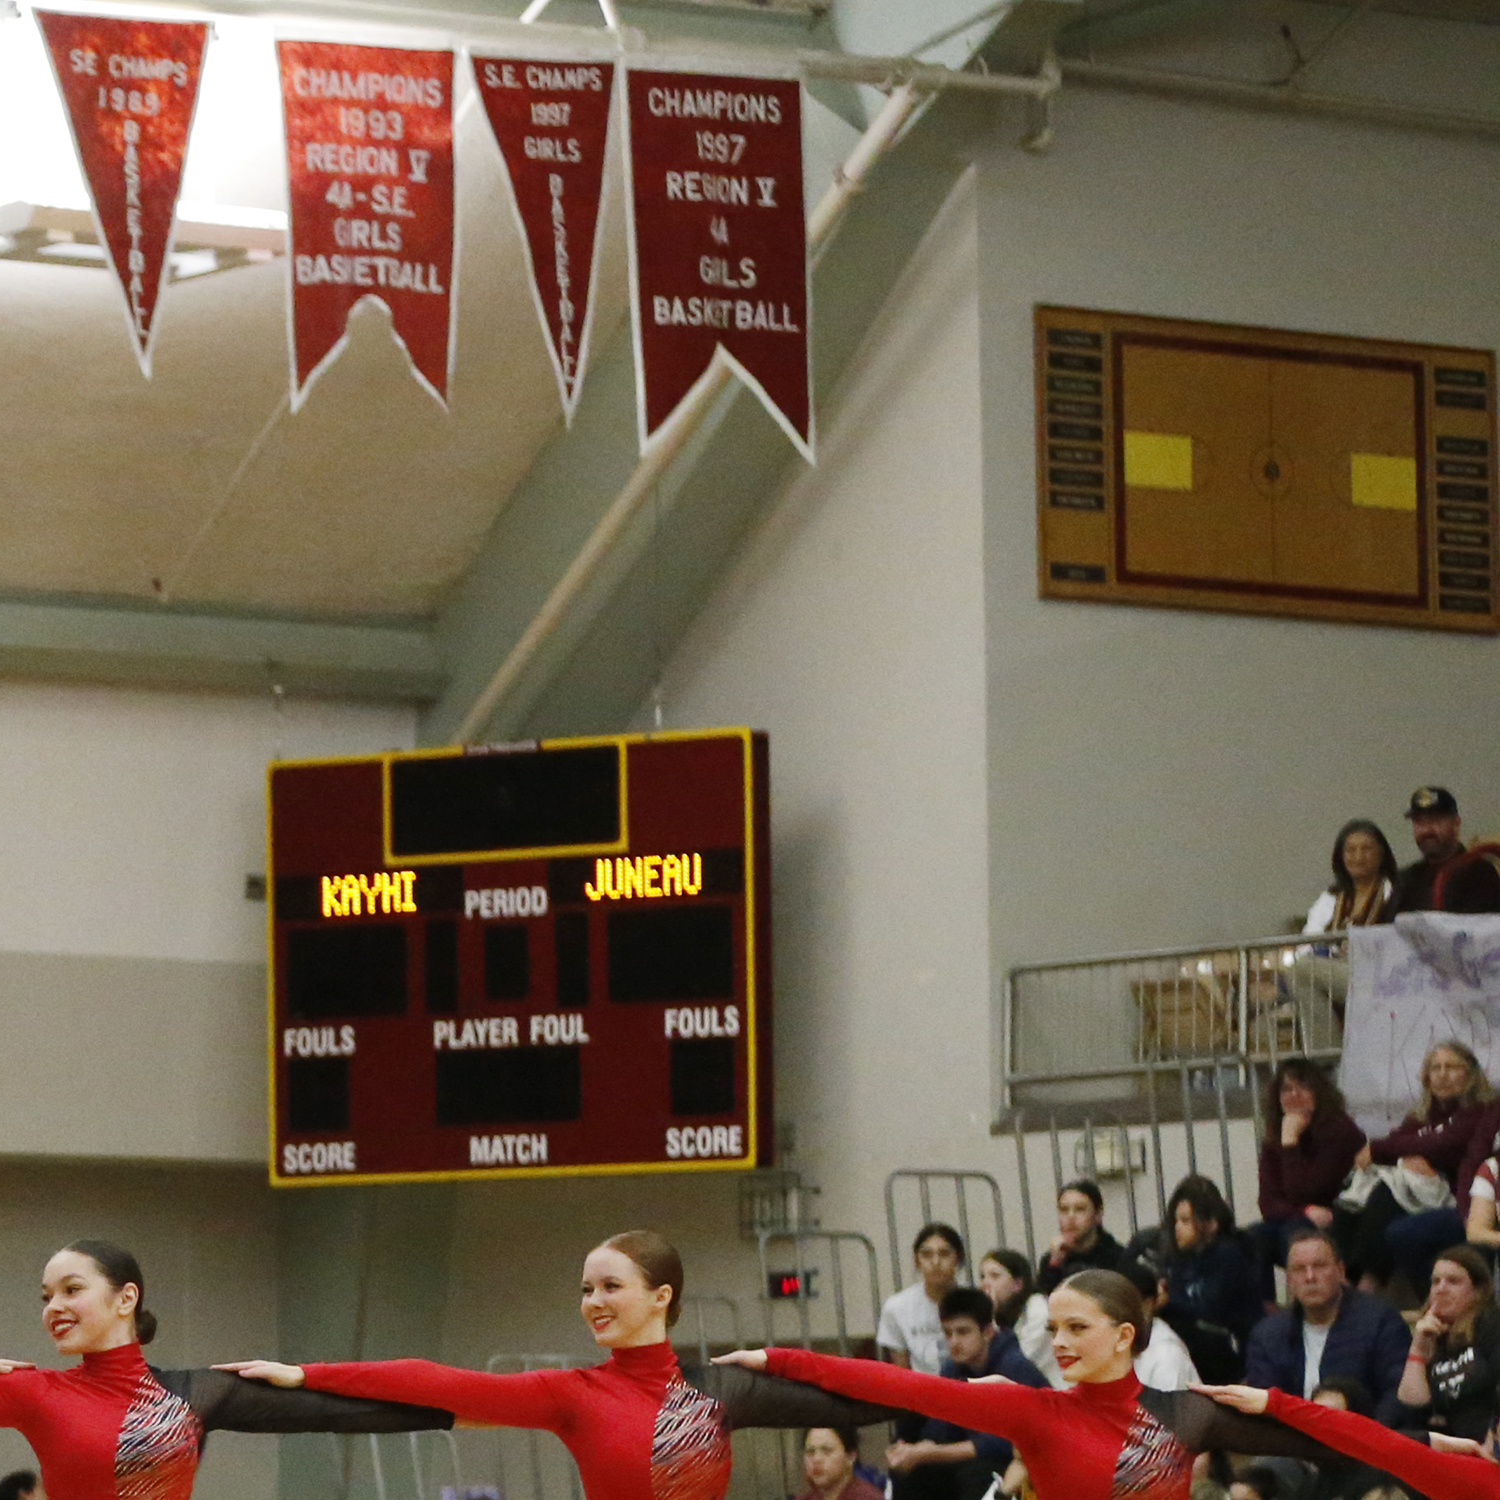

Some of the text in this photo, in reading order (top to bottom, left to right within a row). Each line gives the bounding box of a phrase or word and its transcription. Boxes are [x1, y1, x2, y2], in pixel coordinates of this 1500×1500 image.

[69, 49, 188, 87] SE CHAMPS
[525, 65, 603, 92] CHAMPS
[98, 86, 161, 117] 1989
[293, 66, 444, 109] CHAMPIONS
[530, 102, 571, 126] 1997
[648, 87, 782, 125] CHAMPIONS
[339, 106, 405, 141] 1993
[305, 142, 431, 184] REGION V
[523, 136, 581, 163] GIRLS
[695, 130, 747, 166] 1997
[755, 176, 778, 208] V
[122, 118, 149, 337] BASKETBALL
[321, 870, 417, 917] KAYHI
[585, 853, 702, 901] JUNEAU
[464, 886, 548, 919] PERIOD
[434, 1014, 590, 1049] PLAYER FOUL
[665, 1006, 740, 1038] FOULS
[284, 1026, 355, 1057] FOULS
[470, 1135, 548, 1164] MATCH
[666, 1126, 742, 1157] SCORE
[284, 1143, 356, 1174] SCORE
